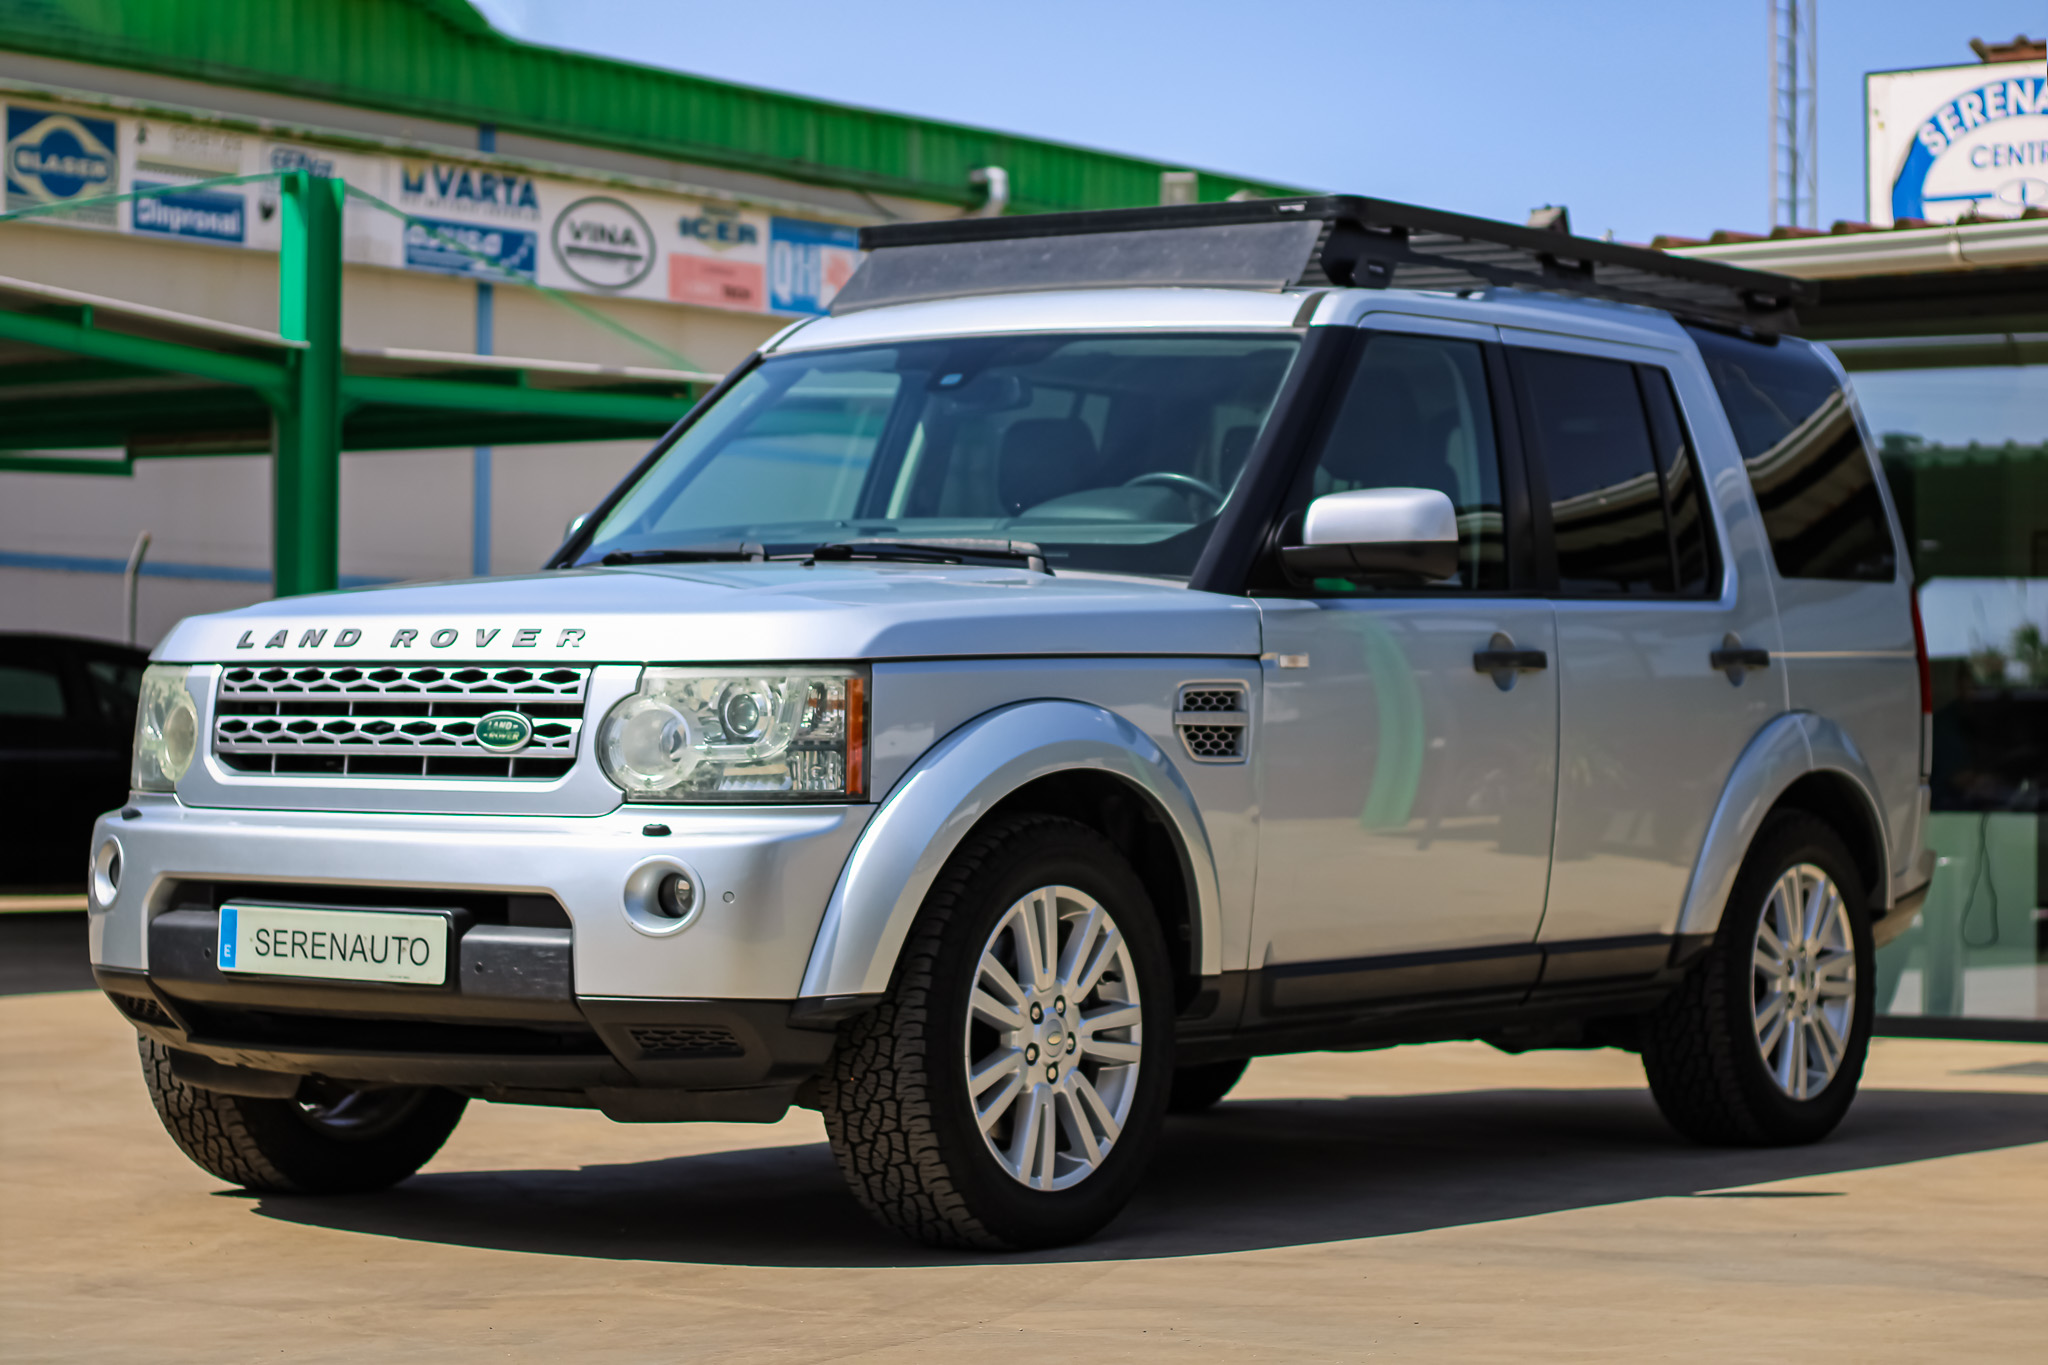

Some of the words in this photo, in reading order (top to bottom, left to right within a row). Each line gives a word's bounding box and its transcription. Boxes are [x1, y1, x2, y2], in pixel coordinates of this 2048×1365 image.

[432, 163, 540, 210] VARTA
[567, 219, 638, 248] VINA
[678, 215, 759, 245] ICER
[236, 628, 363, 649] LAND
[390, 628, 586, 649] ROVER
[223, 943, 232, 958] E
[254, 927, 430, 967] SERENAUTO
